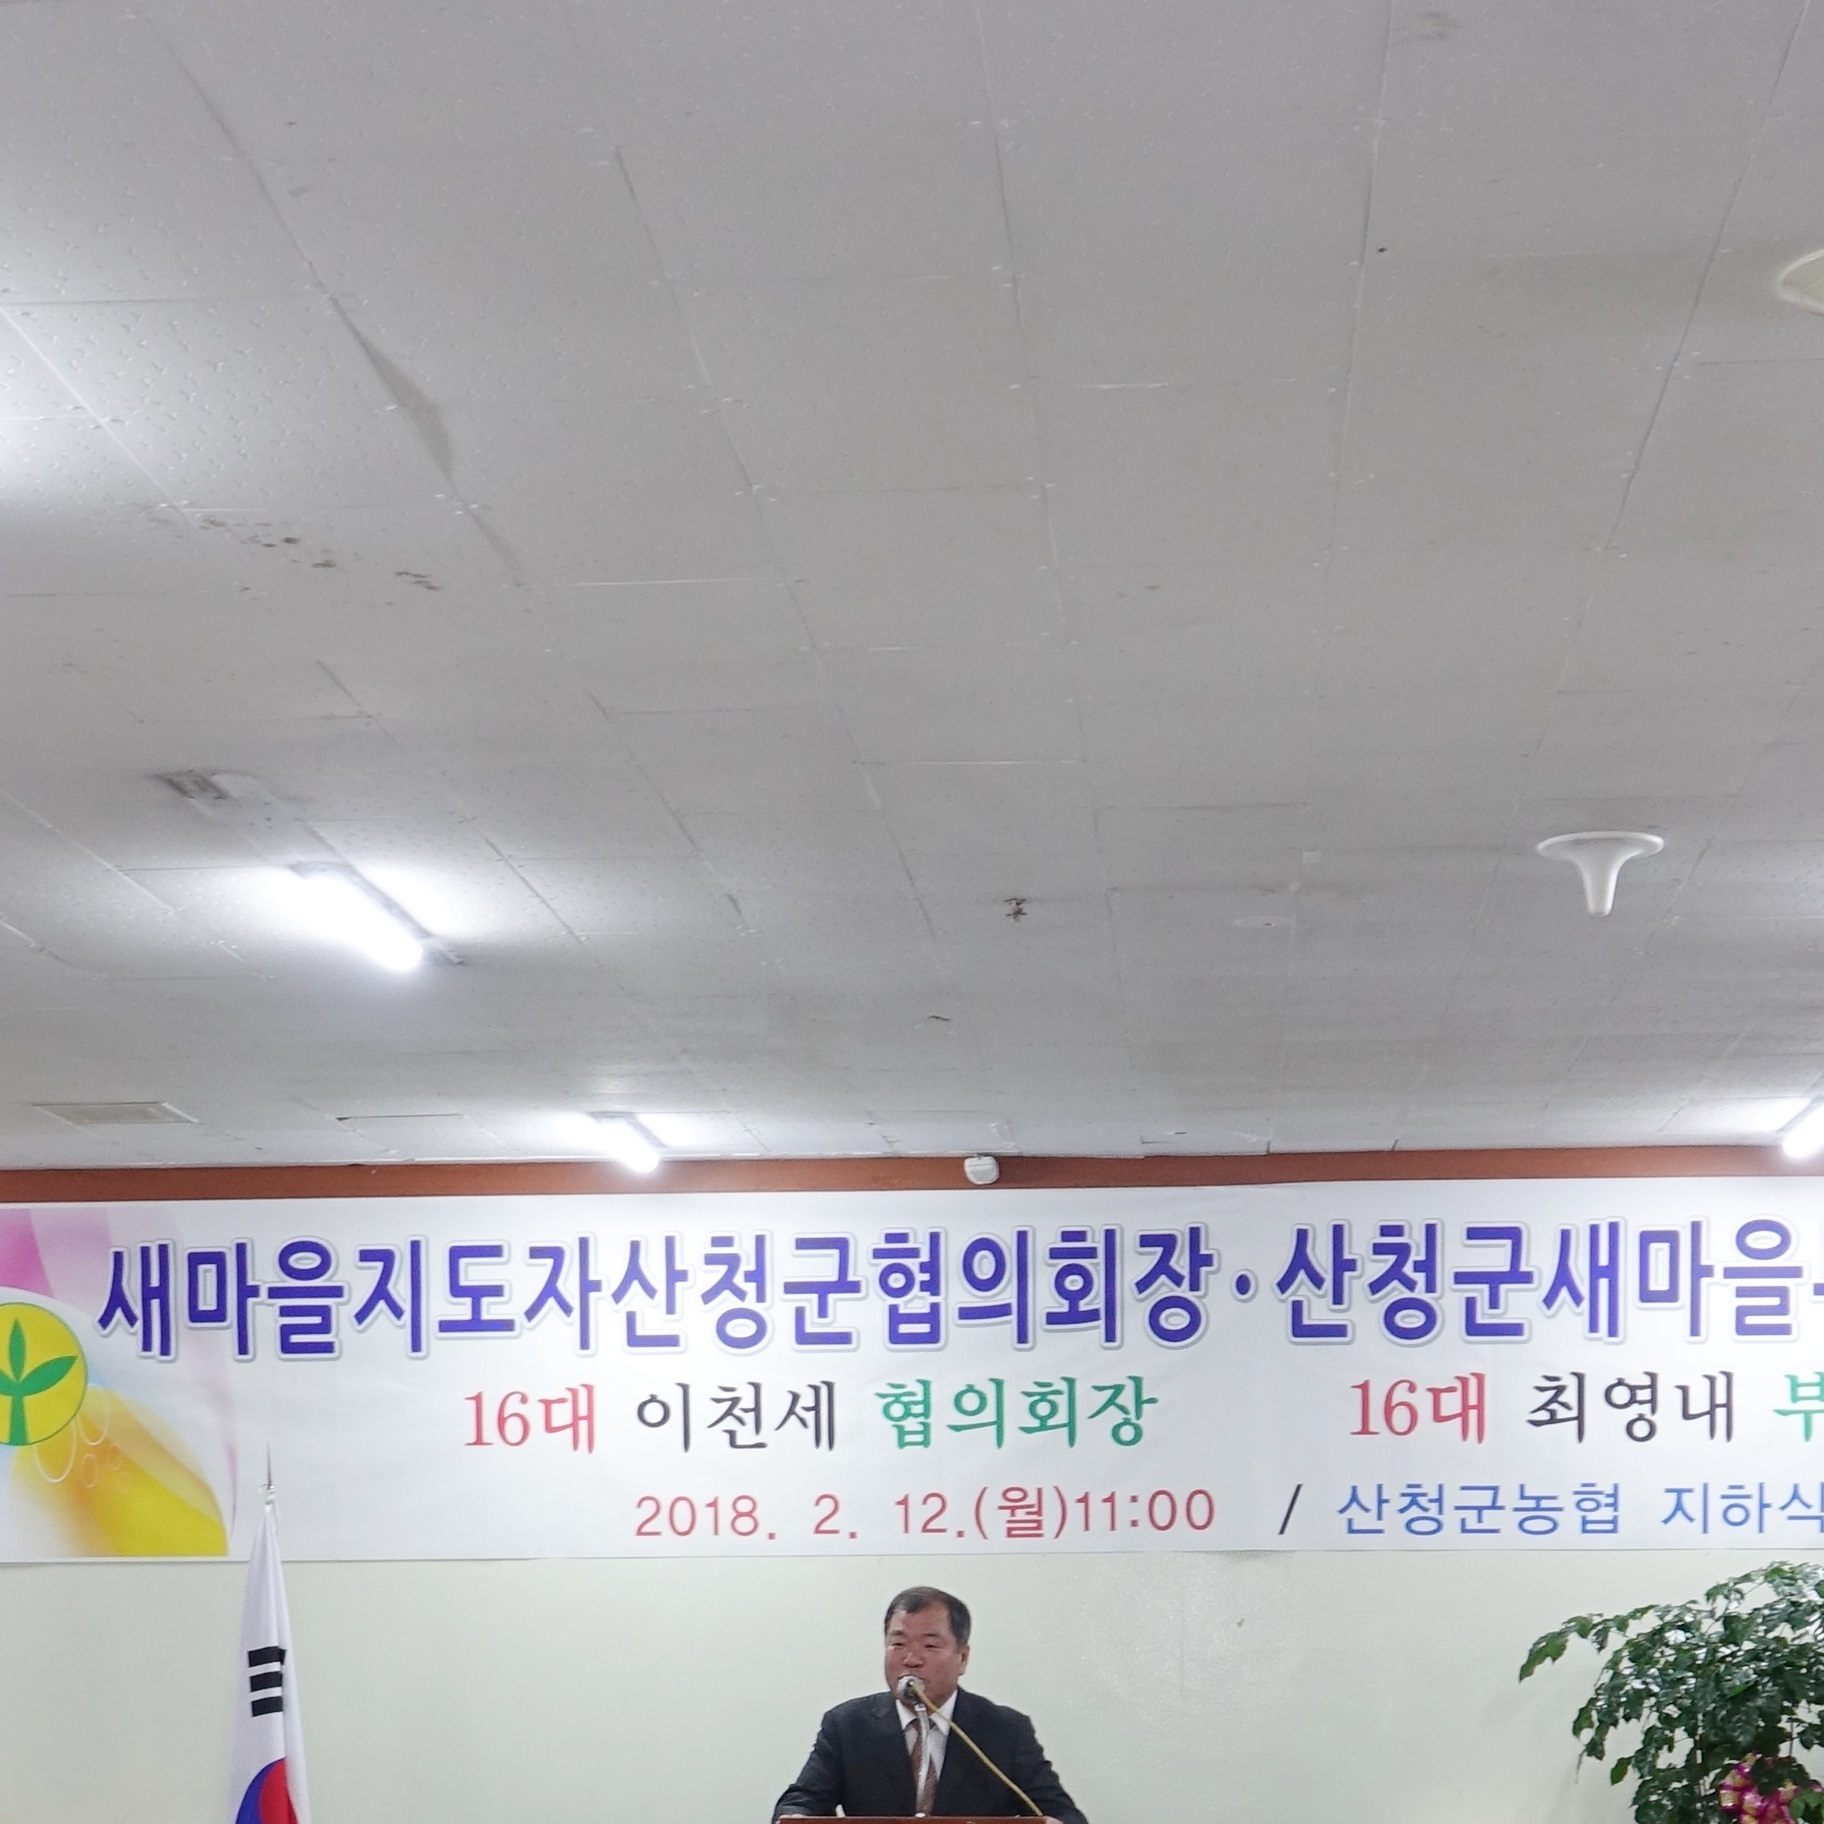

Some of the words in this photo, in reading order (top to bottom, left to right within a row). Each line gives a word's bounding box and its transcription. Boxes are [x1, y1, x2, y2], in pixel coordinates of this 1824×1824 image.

[464, 1383, 595, 1454] 16대
[636, 1379, 836, 1454] 이천세
[874, 1374, 1160, 1450] 협의회장
[1349, 1371, 1486, 1445] 16대
[1525, 1370, 1734, 1444] 최영내
[635, 1494, 776, 1541] 2018.
[813, 1493, 858, 1540] 2.
[1336, 1482, 1619, 1537] 산청군농협
